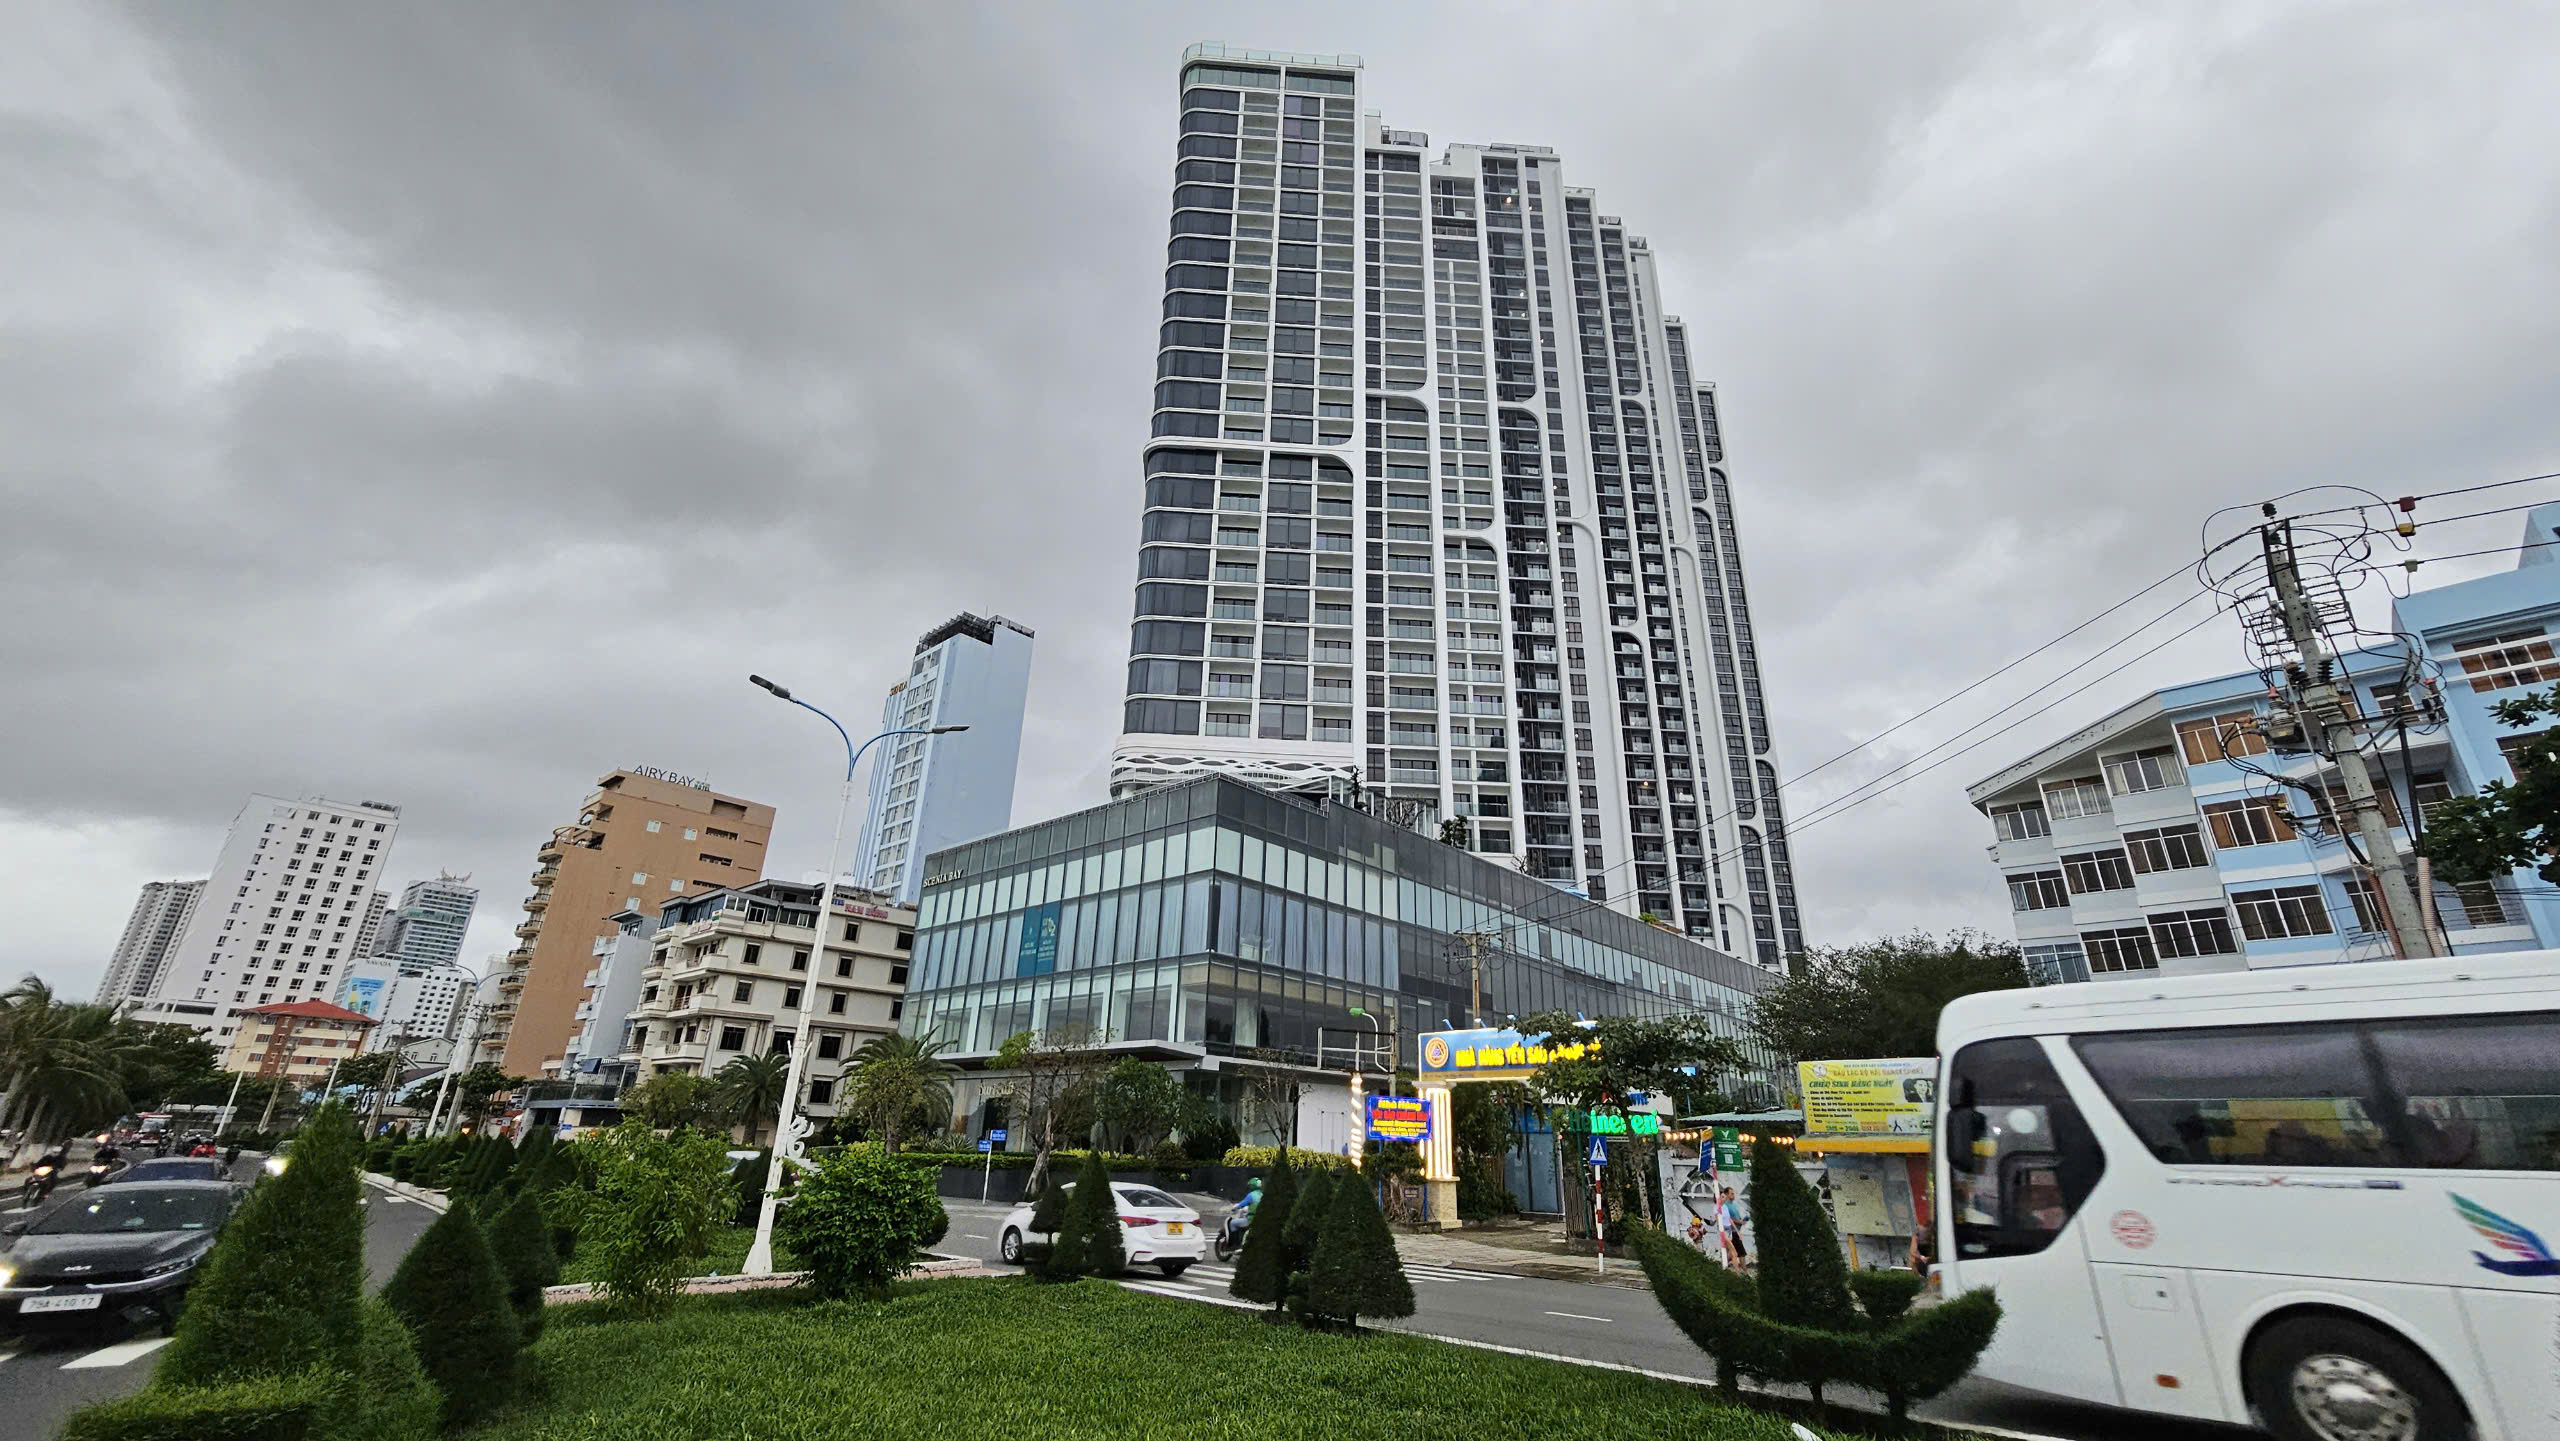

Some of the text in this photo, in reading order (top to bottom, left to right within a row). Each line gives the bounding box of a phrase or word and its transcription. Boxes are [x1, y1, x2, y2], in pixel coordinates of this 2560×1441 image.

[633, 765, 695, 787] AIRY BAY
[923, 869, 964, 888] SCENIA BAY
